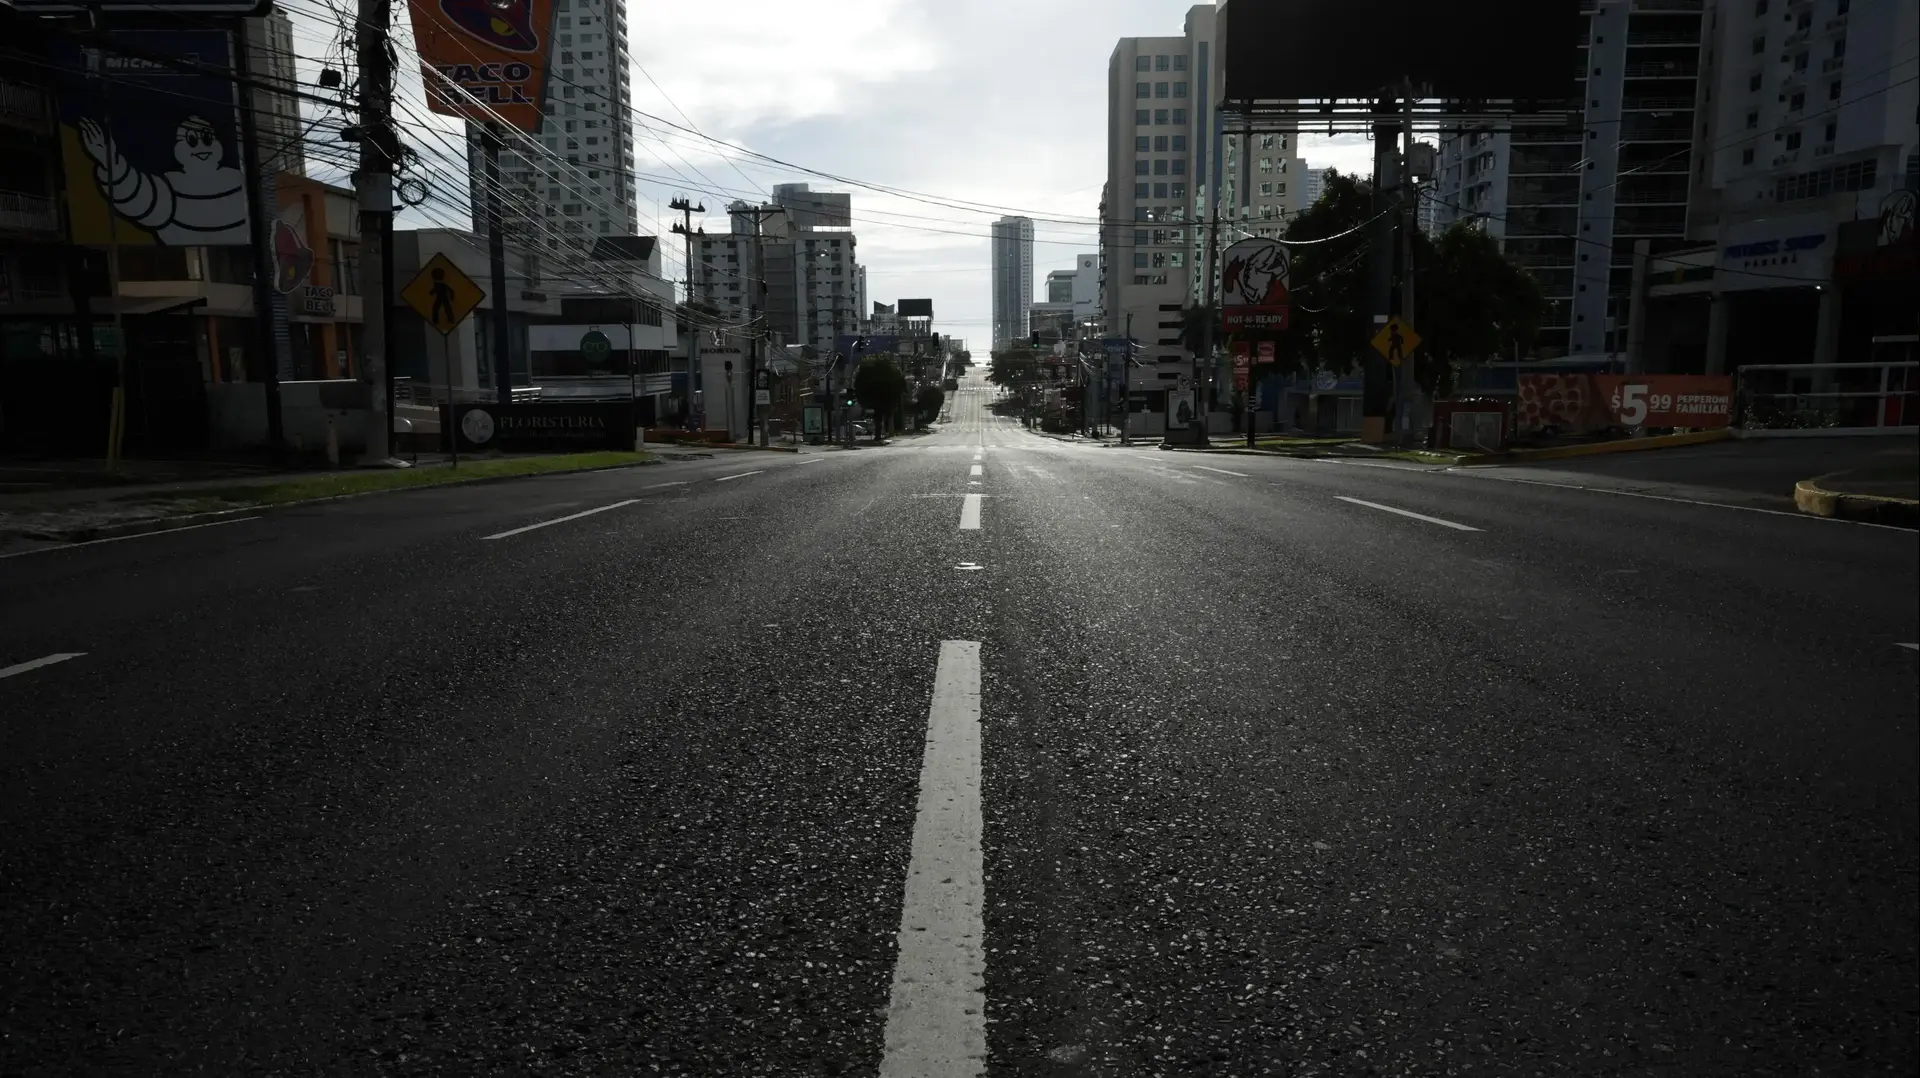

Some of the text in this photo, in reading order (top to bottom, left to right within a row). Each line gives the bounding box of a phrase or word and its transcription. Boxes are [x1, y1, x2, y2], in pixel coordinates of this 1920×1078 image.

[436, 62, 532, 84] TACO
[438, 85, 536, 106] BELL
[303, 286, 334, 298] TACO
[304, 299, 337, 312] BELL
[1676, 394, 1729, 404] PEPPERONI
[1676, 403, 1728, 414] FAMILIAR
